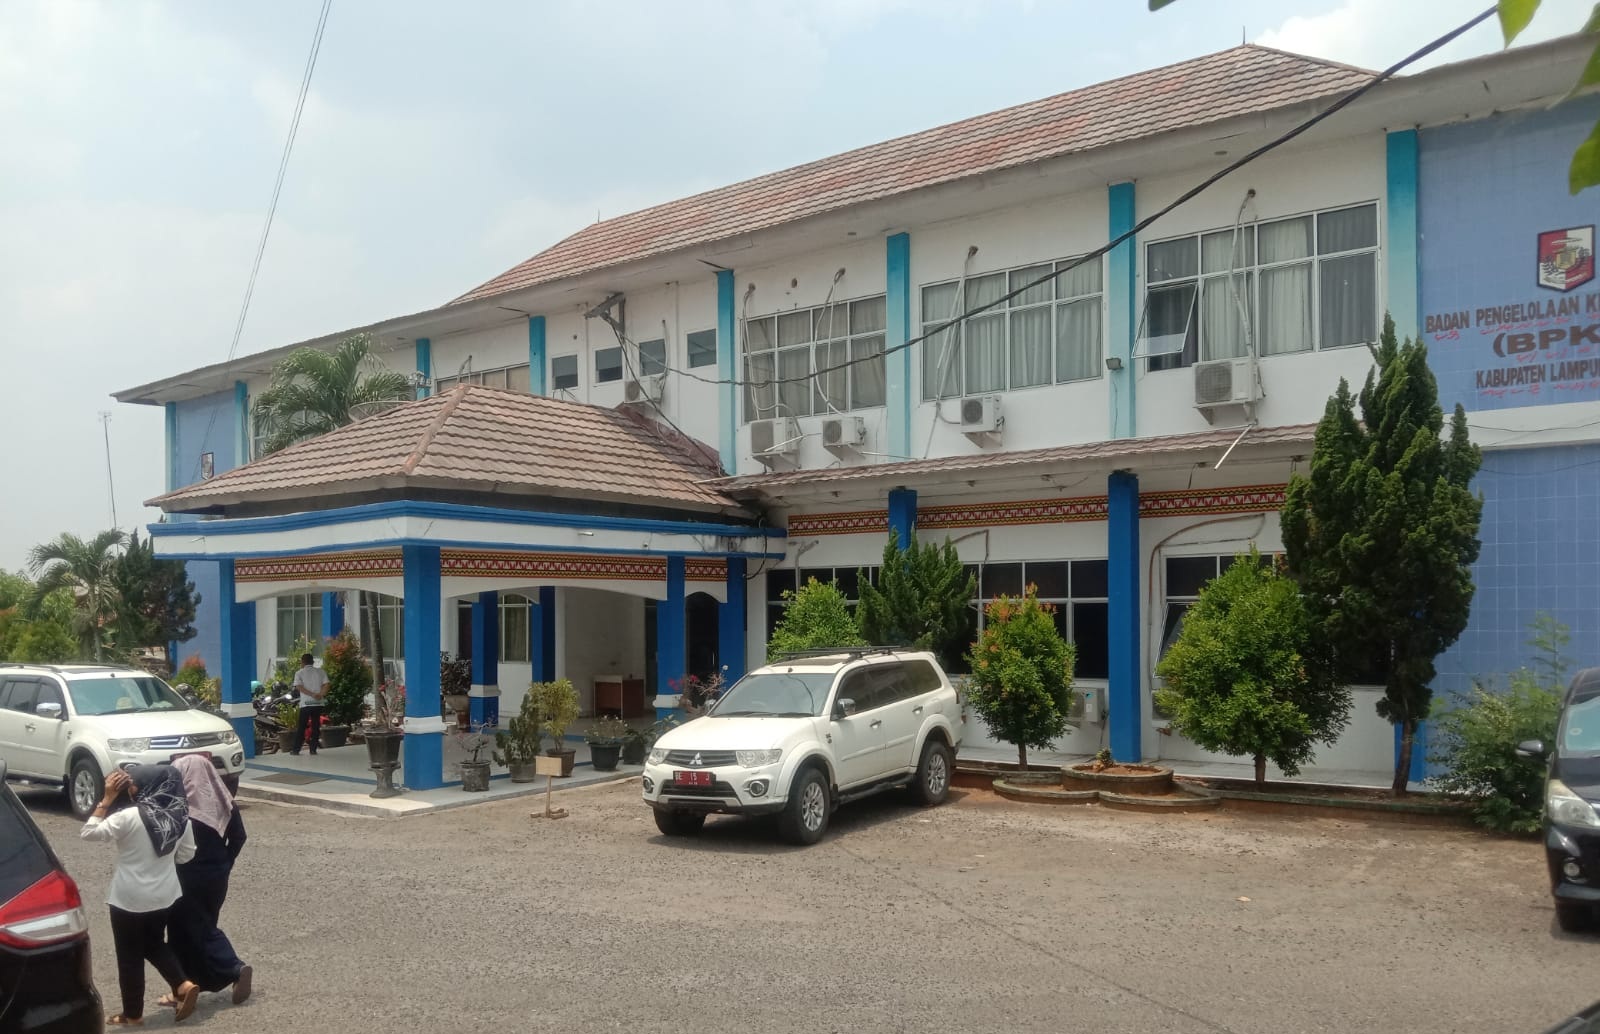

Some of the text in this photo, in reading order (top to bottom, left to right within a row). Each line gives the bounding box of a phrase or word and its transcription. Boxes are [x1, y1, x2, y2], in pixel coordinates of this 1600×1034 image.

[1425, 311, 1470, 333] BADAN
[1476, 295, 1580, 327] PENGELOLAAN
[1586, 293, 1600, 314] K
[1476, 364, 1546, 389] KABUPATEN
[1550, 358, 1600, 382] LAMPU
